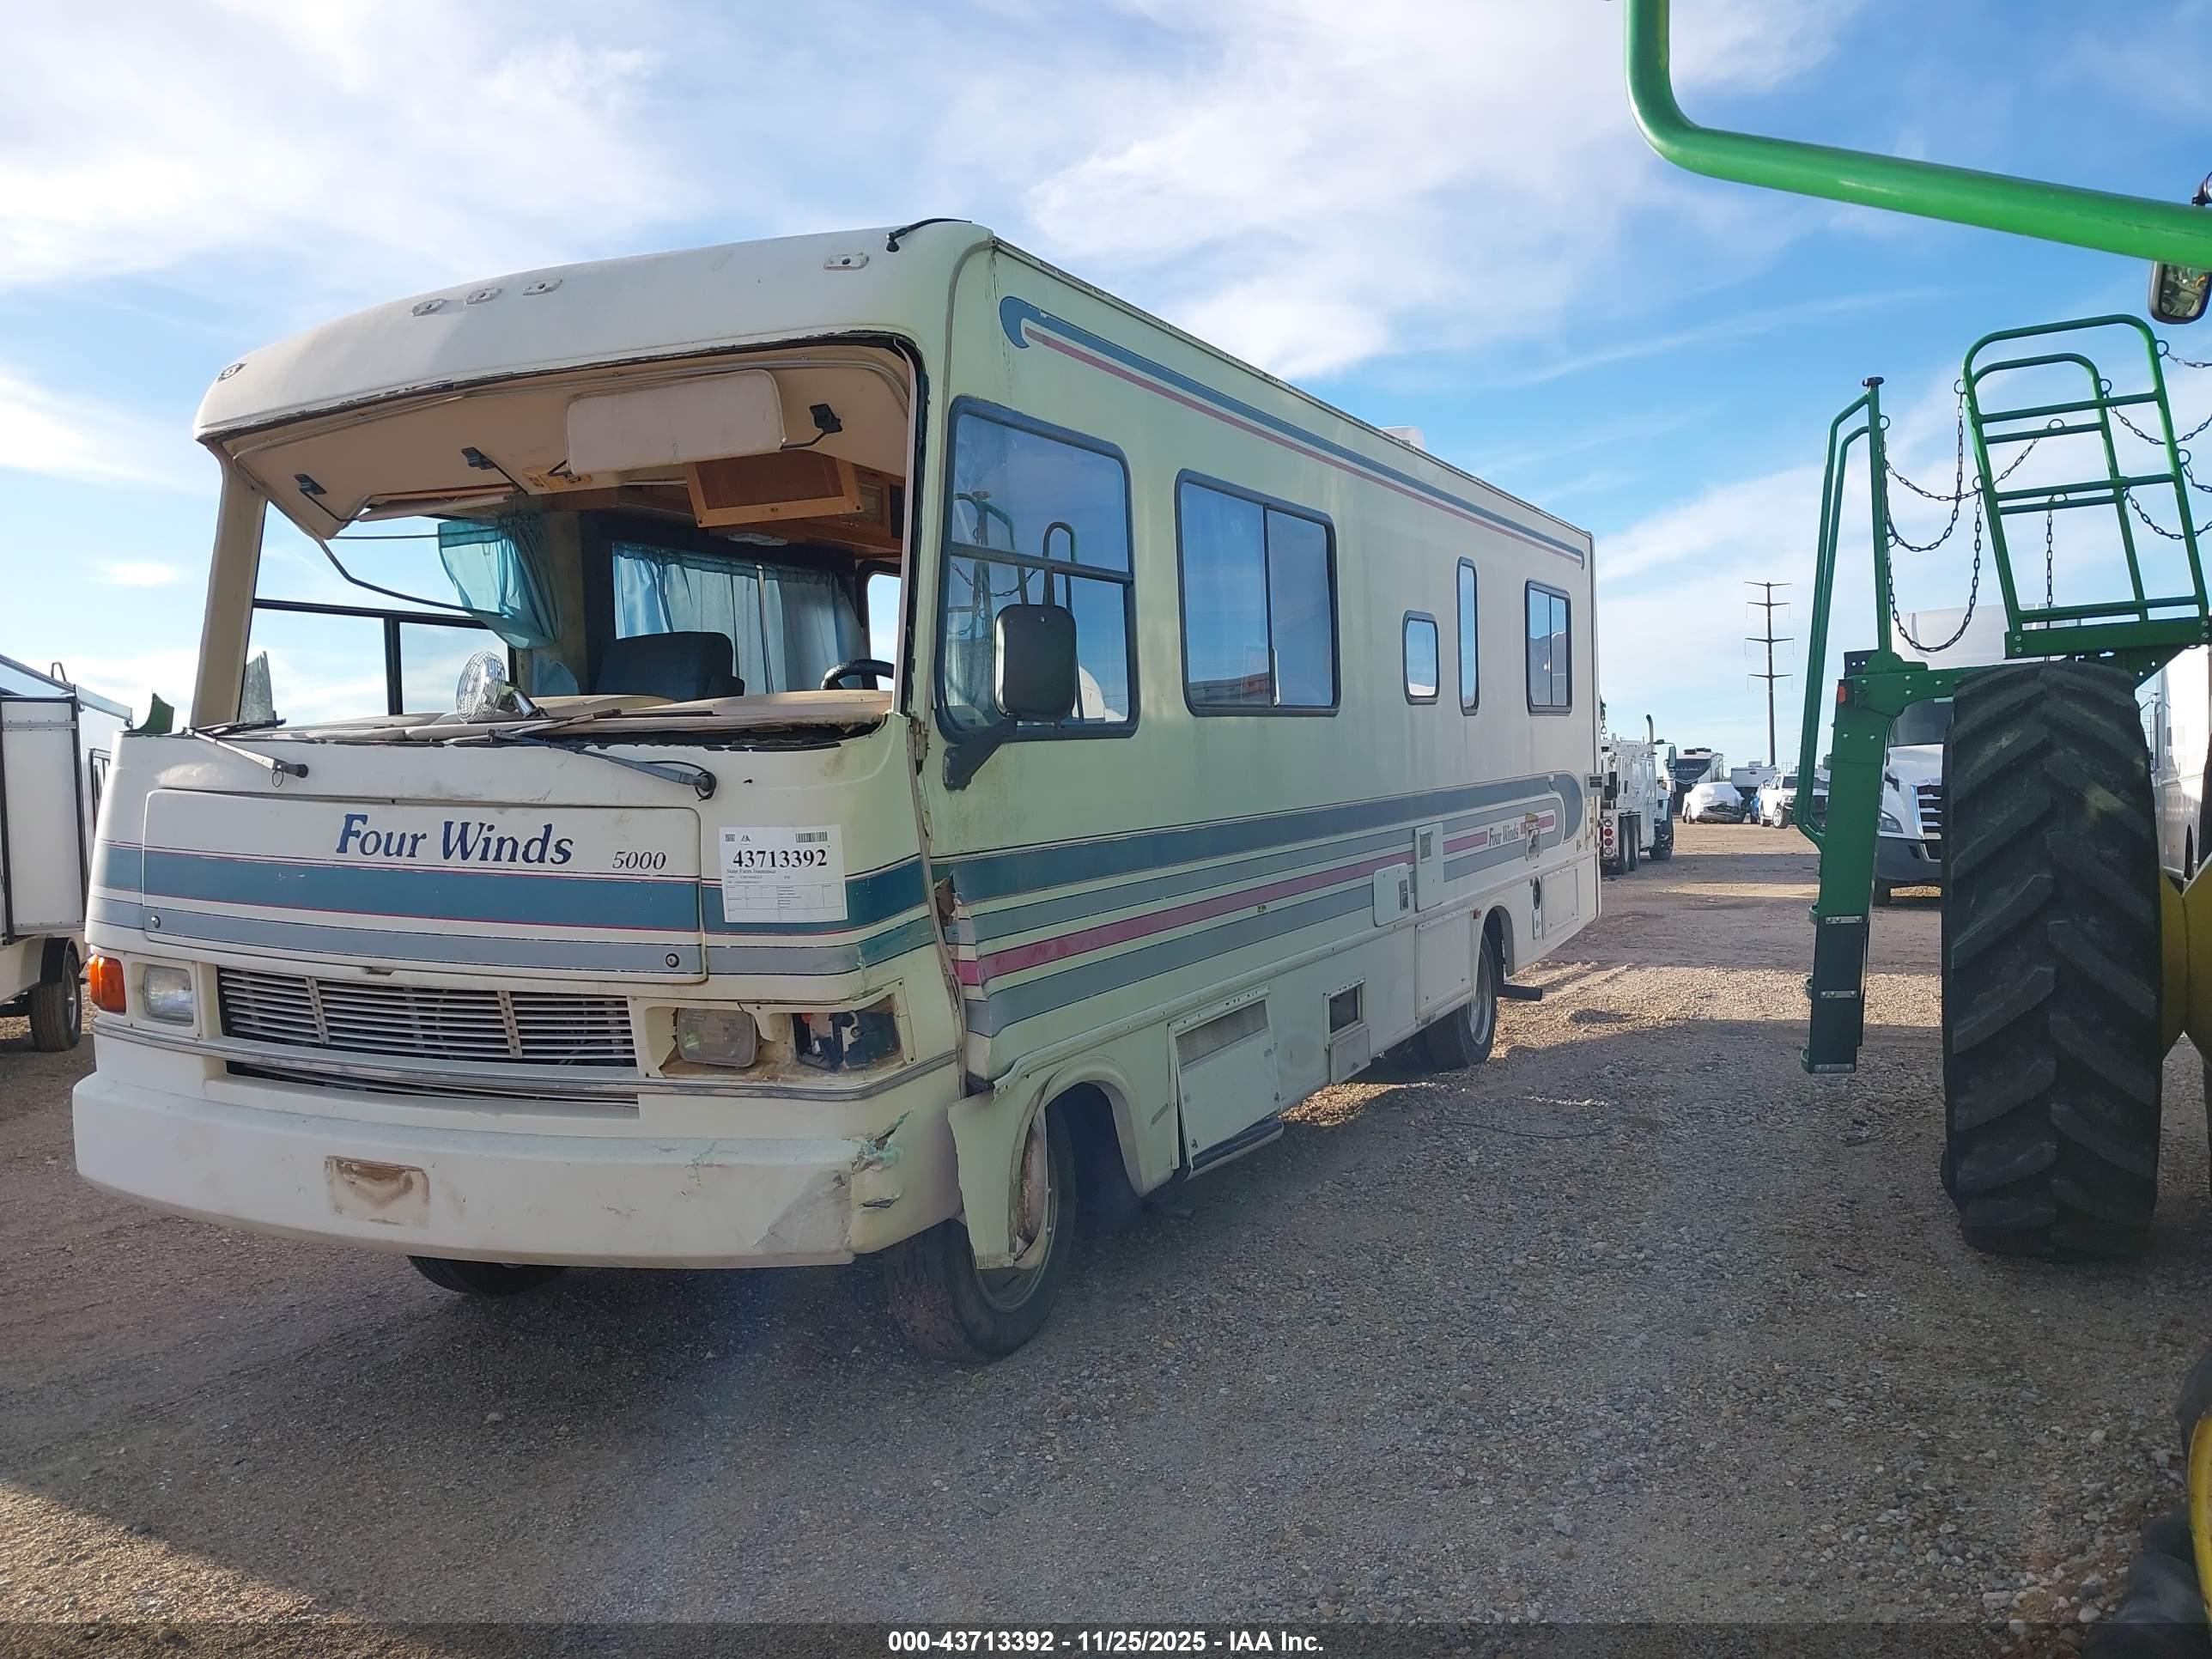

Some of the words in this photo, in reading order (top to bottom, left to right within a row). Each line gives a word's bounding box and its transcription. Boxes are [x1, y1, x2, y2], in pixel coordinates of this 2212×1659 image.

[336, 813, 427, 858] Four
[442, 820, 574, 866] Winds
[611, 851, 667, 871] 5000
[1489, 827, 1502, 847] Four
[1503, 823, 1519, 843] Winds
[732, 848, 828, 868] 43713392
